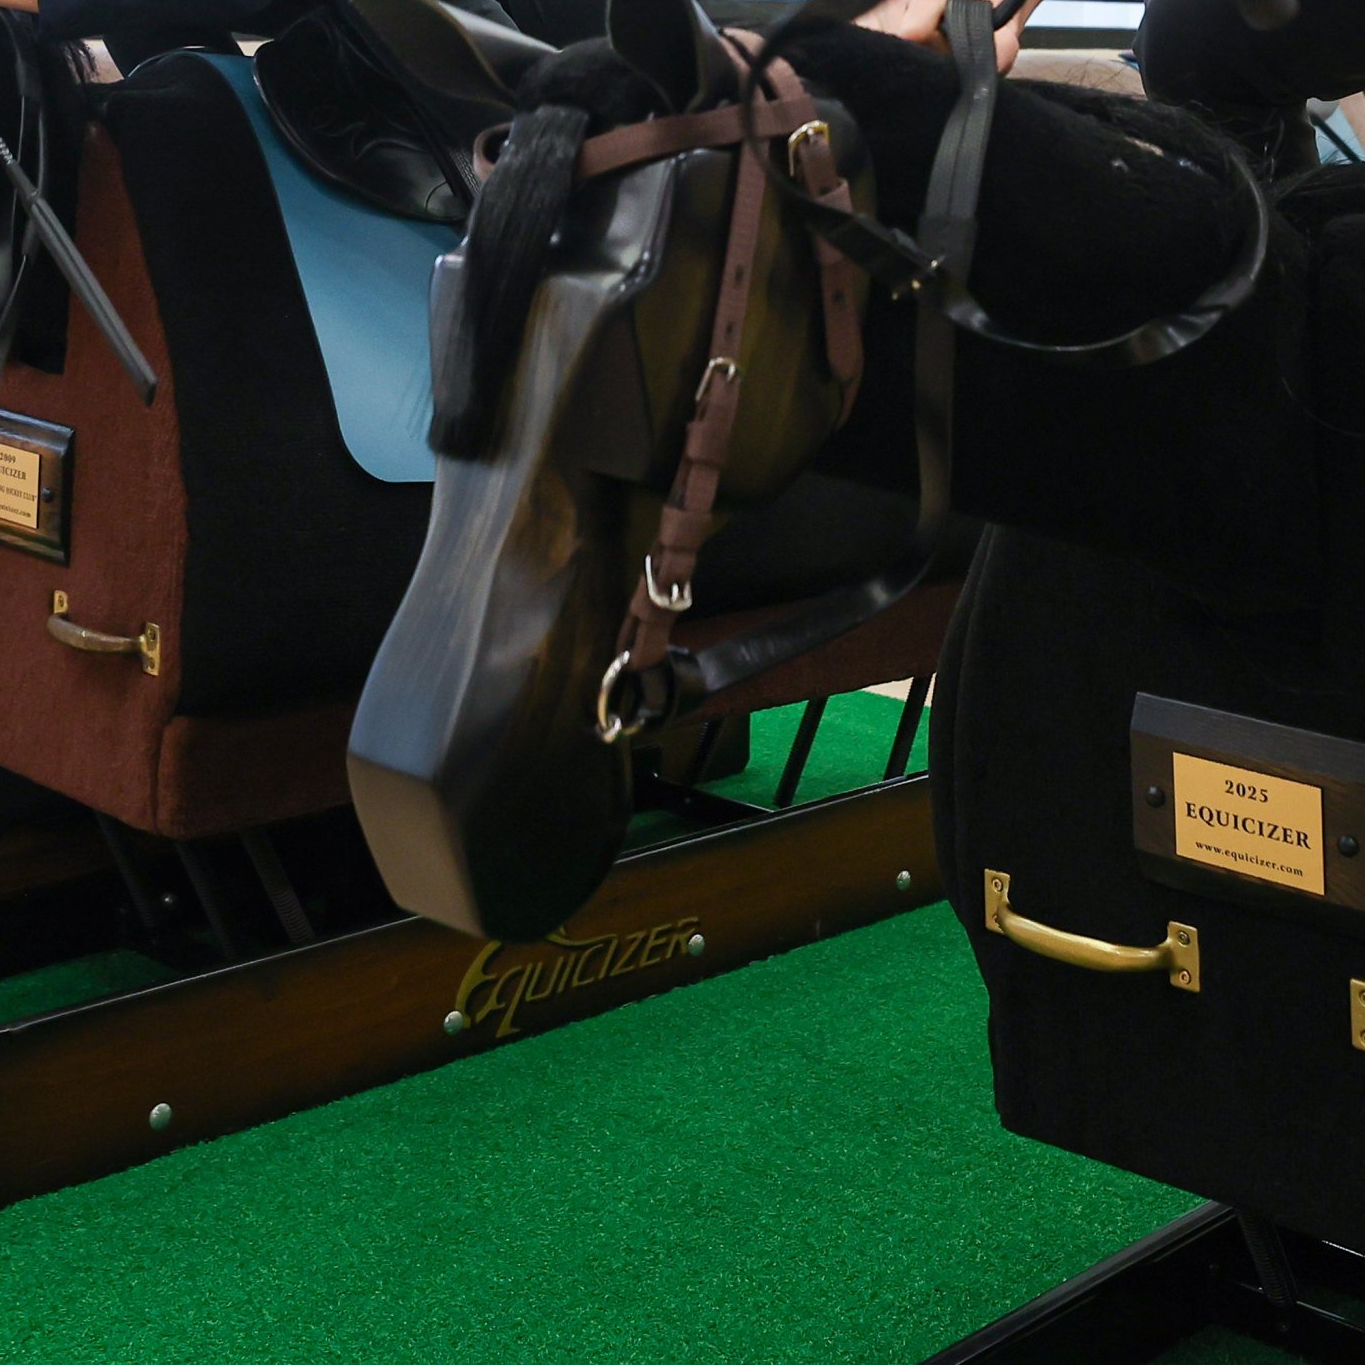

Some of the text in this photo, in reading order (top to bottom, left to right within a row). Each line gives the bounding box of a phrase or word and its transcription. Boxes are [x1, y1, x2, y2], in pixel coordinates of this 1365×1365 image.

[1225, 779, 1269, 803] 2025
[1185, 801, 1312, 850] EQUICIZER
[1195, 841, 1304, 876] www.equicizer.com
